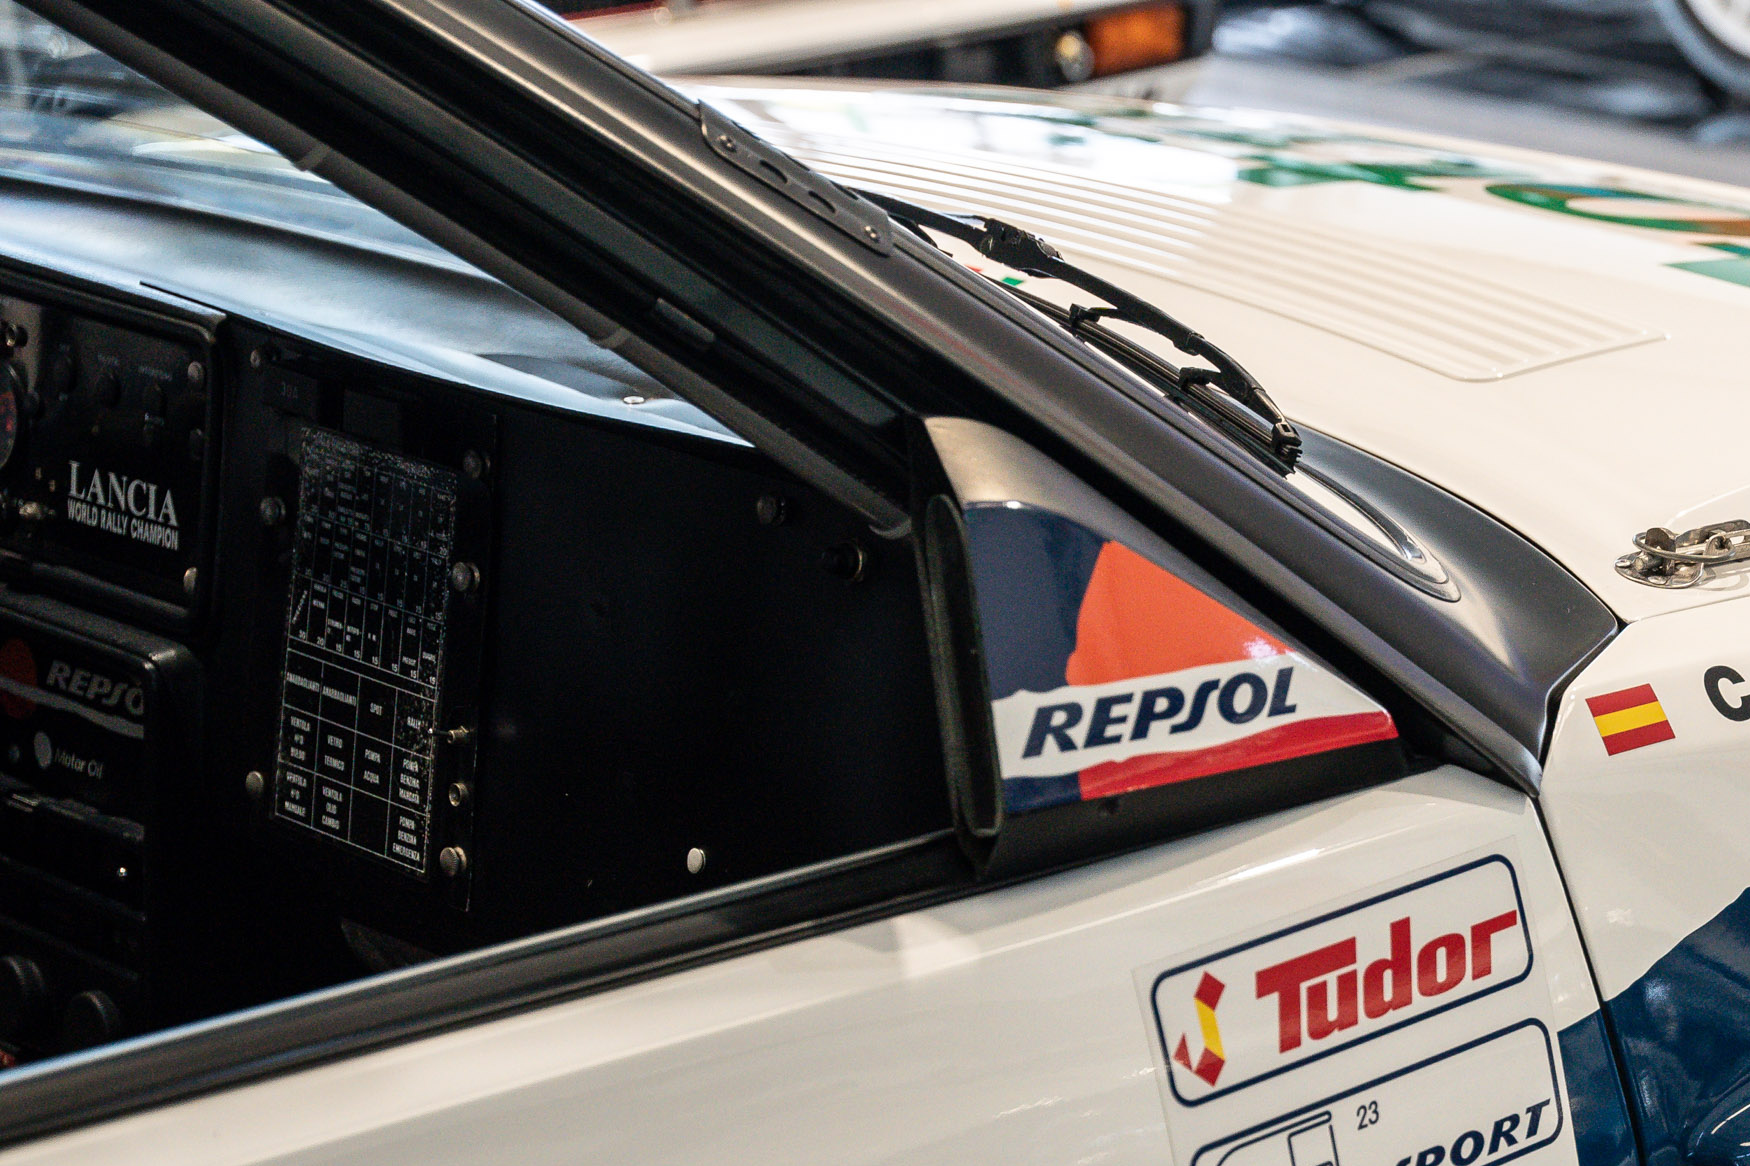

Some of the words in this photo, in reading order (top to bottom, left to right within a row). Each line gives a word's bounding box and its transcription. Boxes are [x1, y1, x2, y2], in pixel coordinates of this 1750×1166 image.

[68, 459, 178, 527] LANCIA
[67, 497, 98, 527] WORLD
[100, 507, 129, 536] RALLY
[130, 516, 179, 551] CHAMPION
[1022, 666, 1298, 760] REPSOL
[54, 748, 86, 775] Motor
[87, 761, 104, 780] Oil
[1255, 909, 1518, 1055] Tudor
[1356, 1100, 1380, 1131] 23
